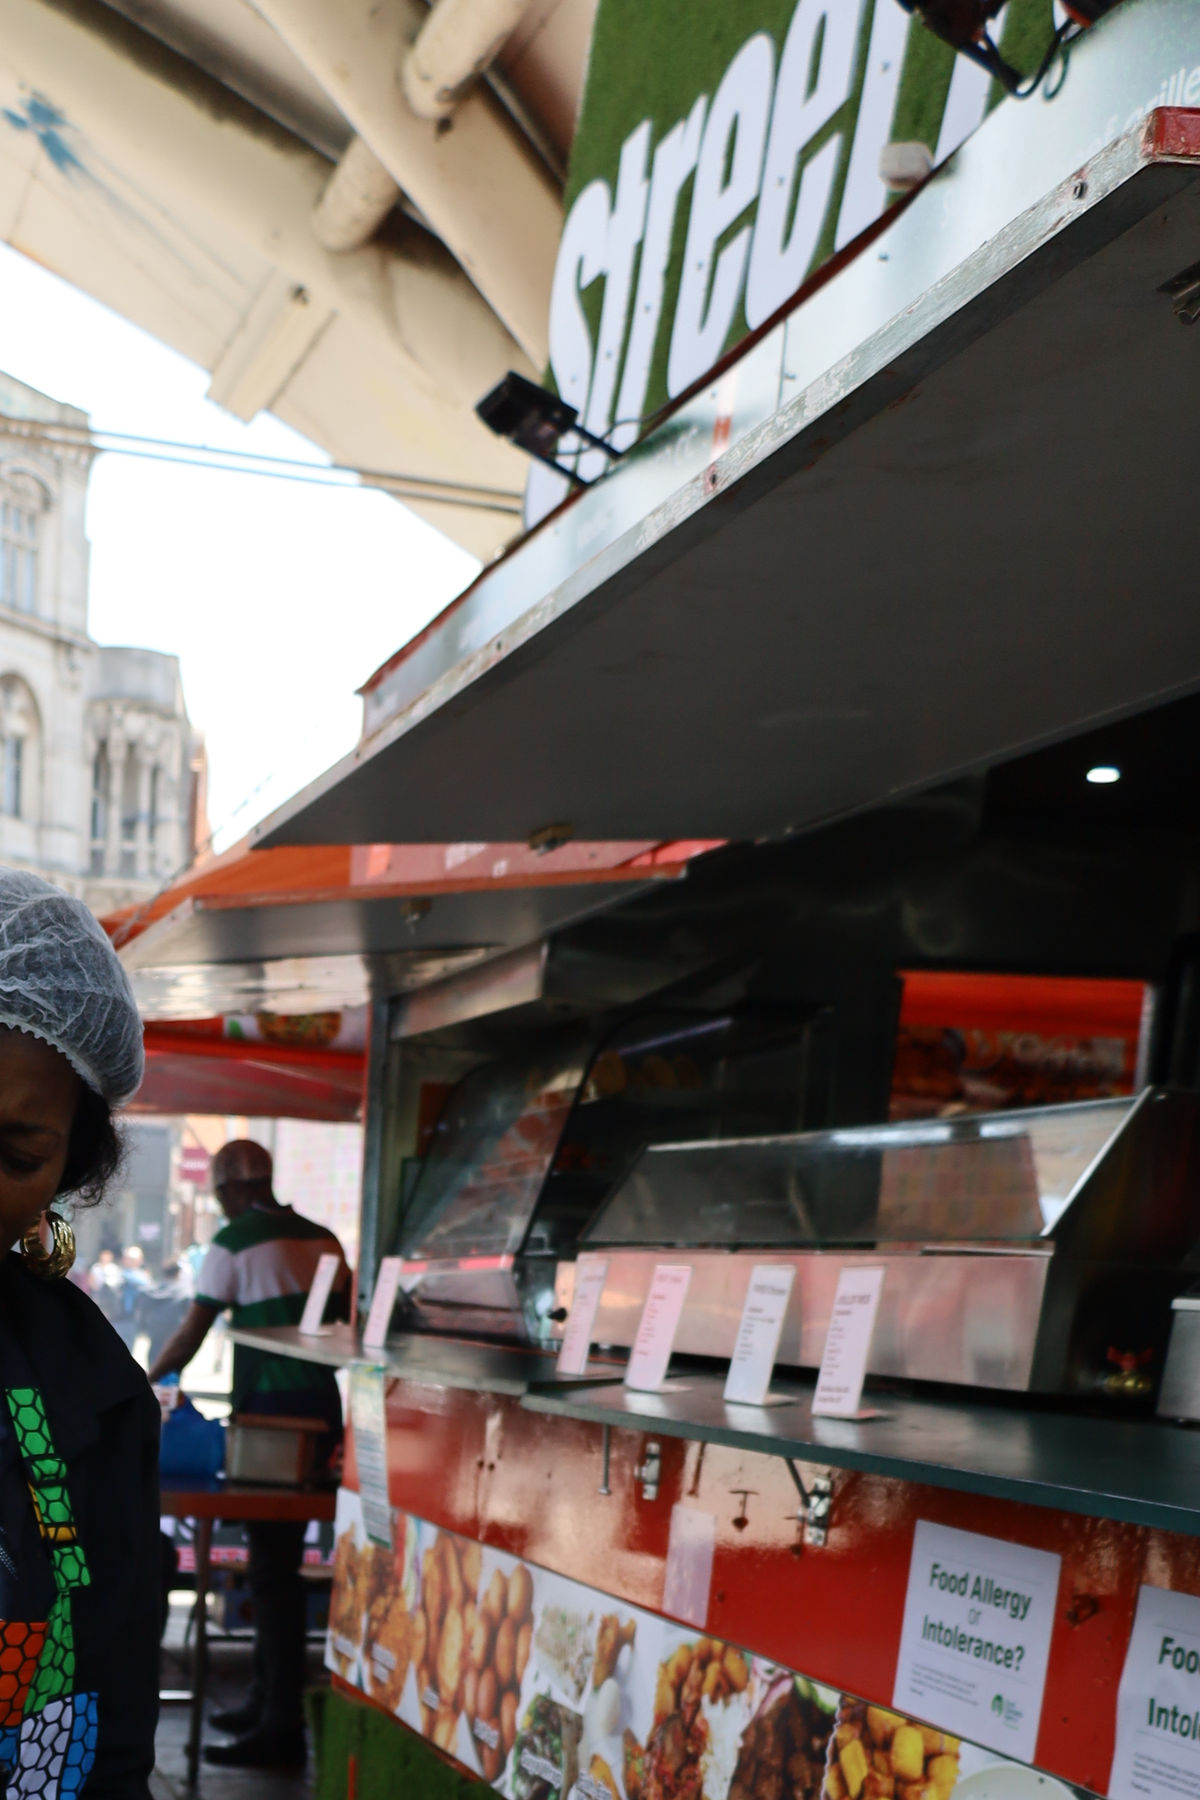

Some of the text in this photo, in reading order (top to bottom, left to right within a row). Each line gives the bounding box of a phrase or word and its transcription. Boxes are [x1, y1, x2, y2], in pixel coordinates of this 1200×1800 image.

[929, 1563, 1033, 1621] Food Allergy
[968, 1608, 982, 1626] or
[922, 1615, 1025, 1672] Intolerance?
[1158, 1635, 1200, 1675] Foo
[1148, 1697, 1200, 1741] Intol
